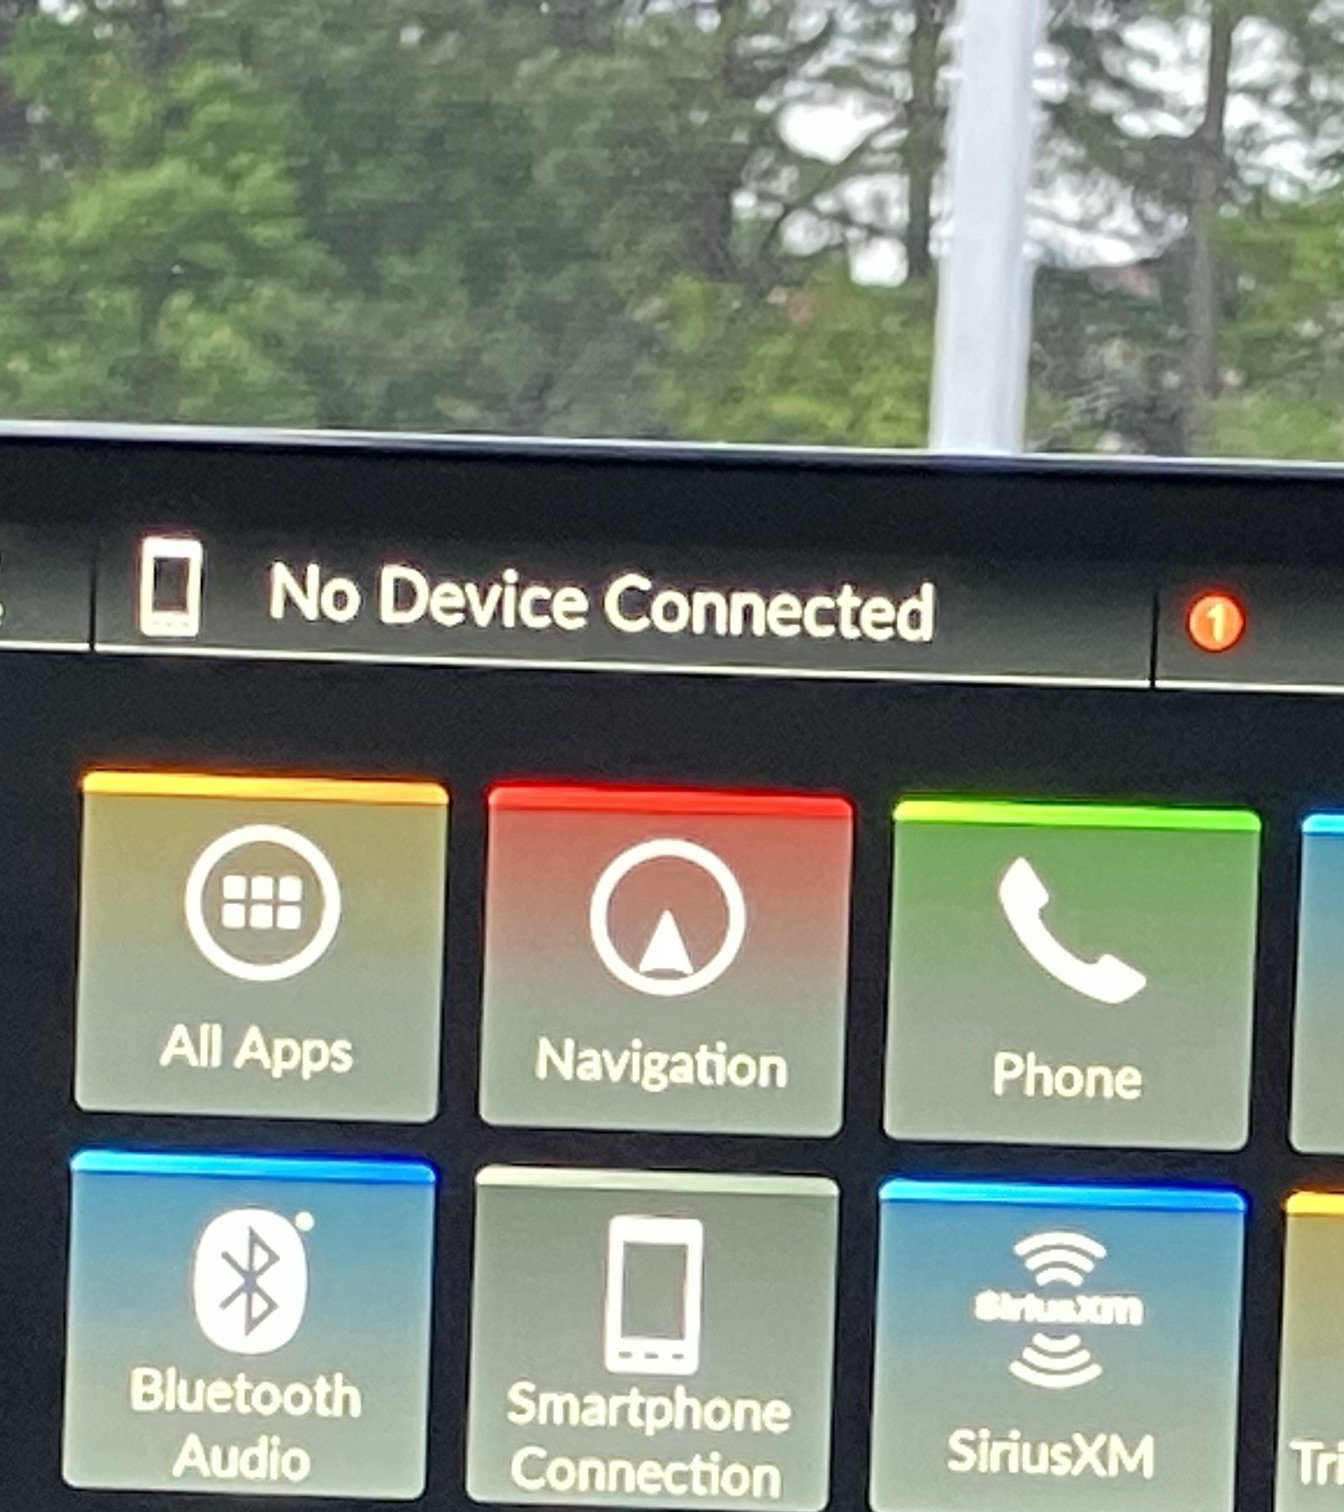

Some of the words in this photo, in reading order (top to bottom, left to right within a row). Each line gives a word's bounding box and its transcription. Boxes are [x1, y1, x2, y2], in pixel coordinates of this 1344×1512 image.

[270, 561, 361, 623] No
[380, 563, 589, 631] Device
[604, 573, 934, 642] Connected
[159, 1023, 222, 1068] All
[233, 1025, 354, 1081] Apps
[536, 1036, 788, 1093] Navigation
[993, 1051, 1142, 1100] Phone
[130, 1366, 362, 1418] Bluetooth
[507, 1381, 792, 1437] Smartphone
[172, 1432, 311, 1483] Audio
[509, 1444, 782, 1501] Connection
[947, 1428, 1154, 1479] SiriusXM
